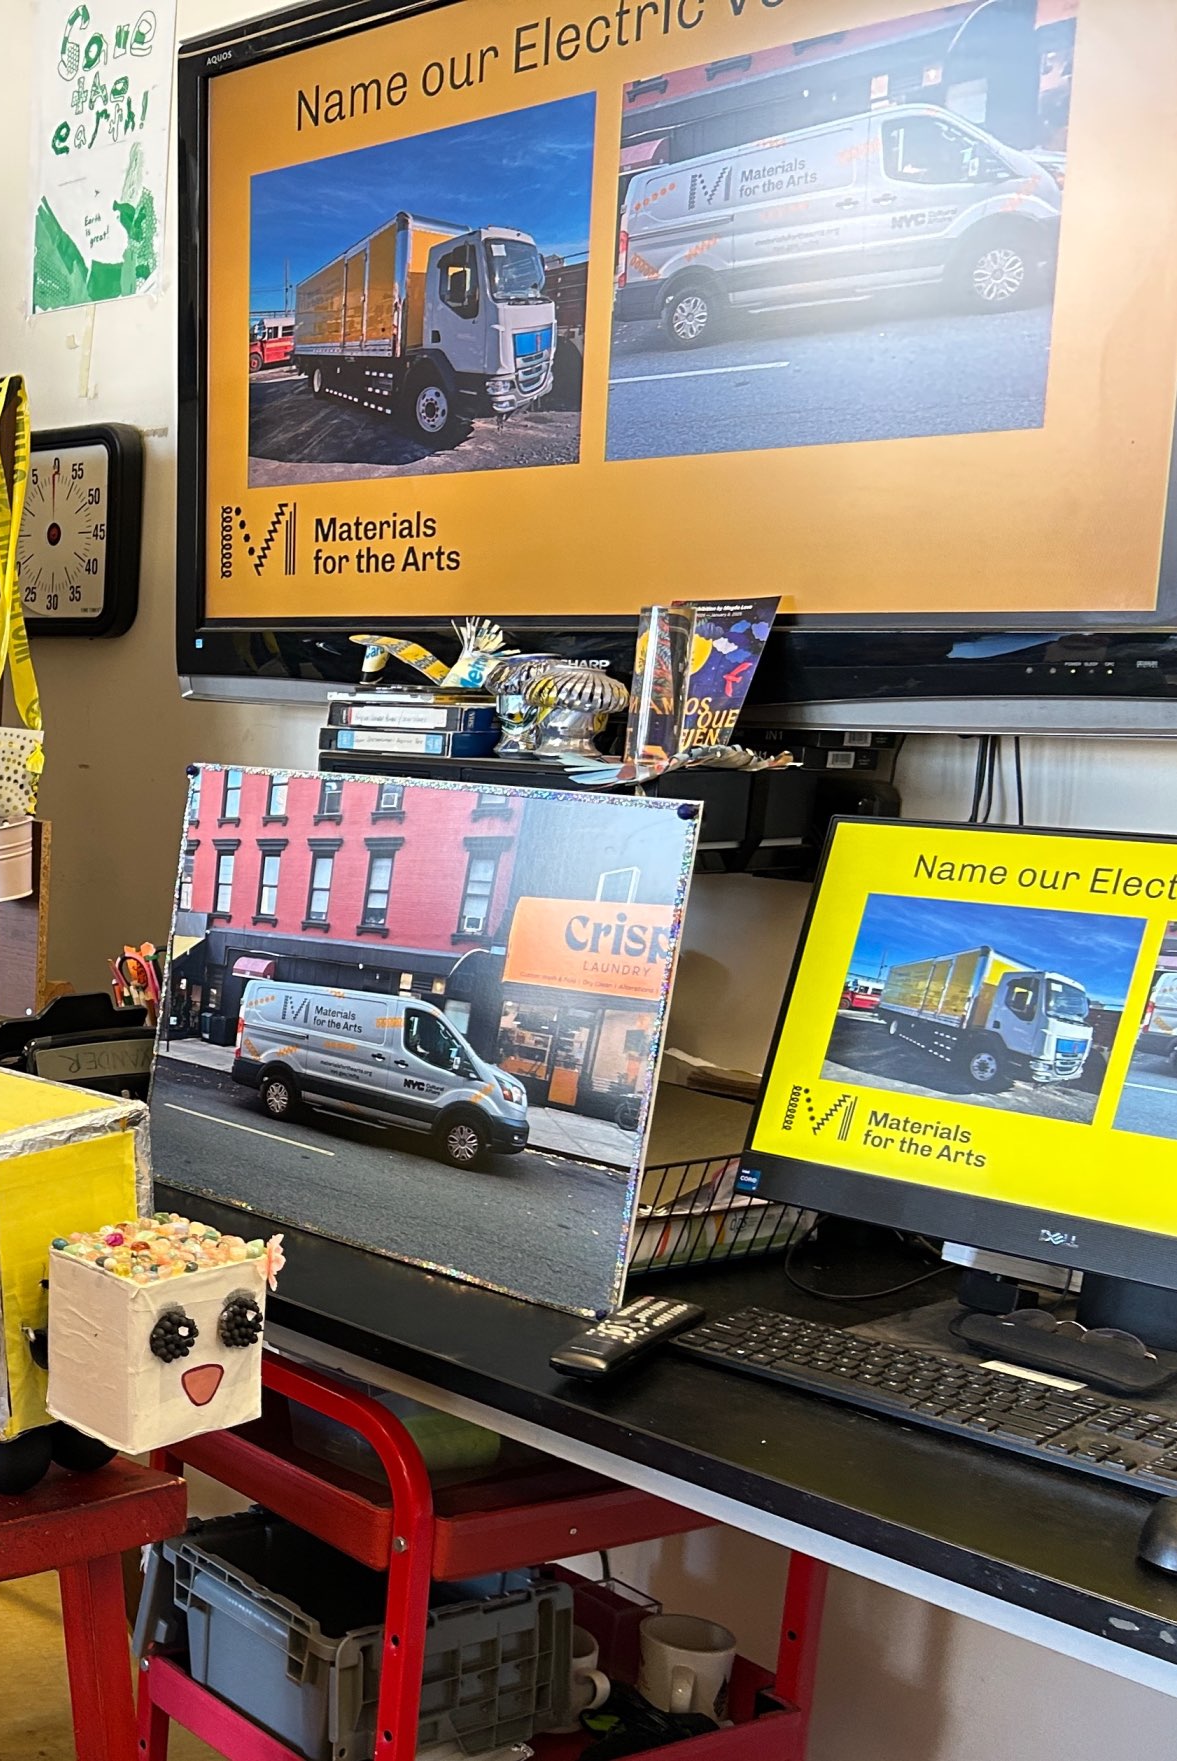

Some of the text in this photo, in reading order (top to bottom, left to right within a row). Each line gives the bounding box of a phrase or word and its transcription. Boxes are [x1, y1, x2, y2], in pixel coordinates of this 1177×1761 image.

[206, 50, 232, 66] AQUOS
[71, 71, 129, 115] the
[297, 71, 408, 131] Name
[422, 45, 499, 97] our
[741, 158, 806, 182] Materials
[739, 172, 817, 198] for the Arts
[84, 213, 101, 226] Earth
[891, 213, 926, 229] NYC
[32, 469, 38, 485] 5
[71, 463, 84, 480] 55
[88, 488, 101, 505] 50
[92, 524, 106, 541] 45
[314, 510, 437, 543] Materials
[85, 558, 98, 575] 40
[313, 545, 461, 575] for the Arts
[24, 587, 37, 603] 25
[46, 594, 58, 611] 30
[69, 586, 81, 602] 35
[696, 709, 740, 730] QUE
[913, 853, 1008, 885] Name
[1017, 866, 1080, 891] our
[565, 912, 671, 964] Crisp
[583, 960, 652, 978] LAUNDRY
[314, 1005, 356, 1020] Materials
[313, 1016, 363, 1033] for the Arts
[403, 1078, 425, 1092] NYC
[868, 1110, 972, 1144] Materials
[862, 1129, 987, 1168] for the Arts
[1038, 1229, 1079, 1248] DELL
